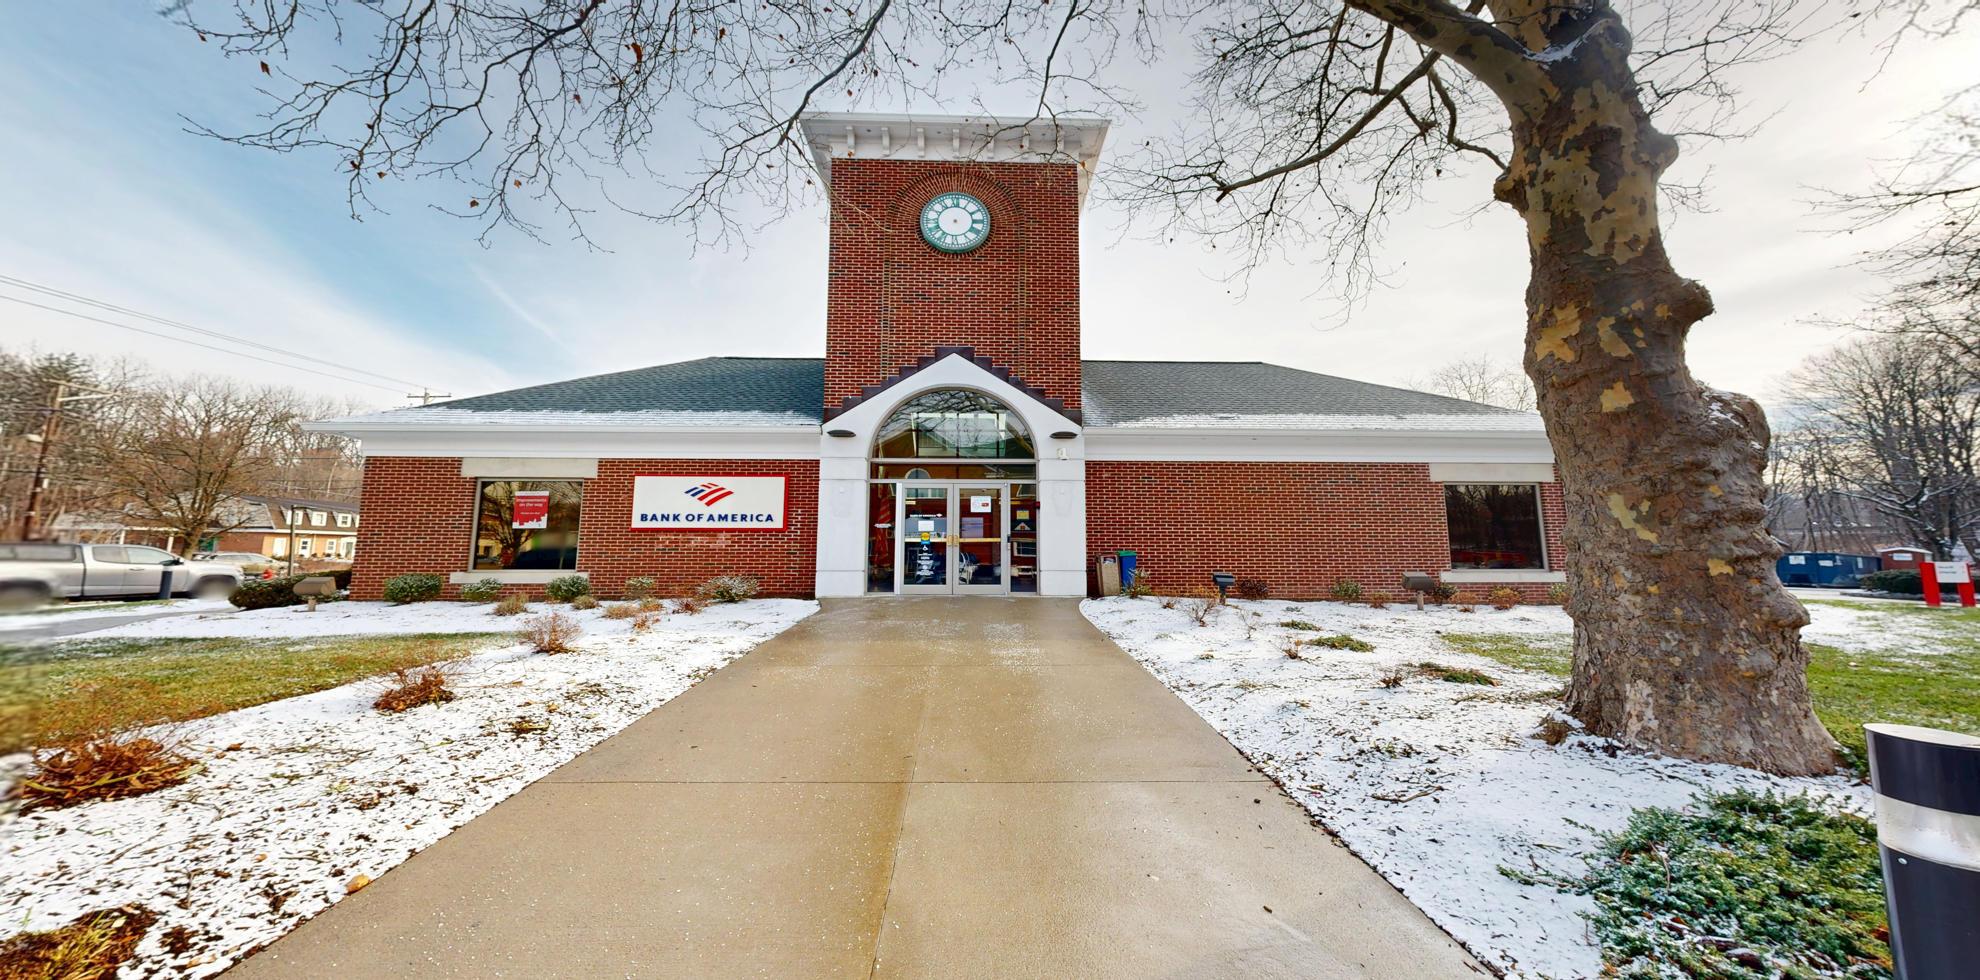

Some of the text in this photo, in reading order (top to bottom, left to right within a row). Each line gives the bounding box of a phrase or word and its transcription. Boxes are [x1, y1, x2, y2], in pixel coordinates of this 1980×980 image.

[640, 513, 774, 522] BANK OF AMERICA
